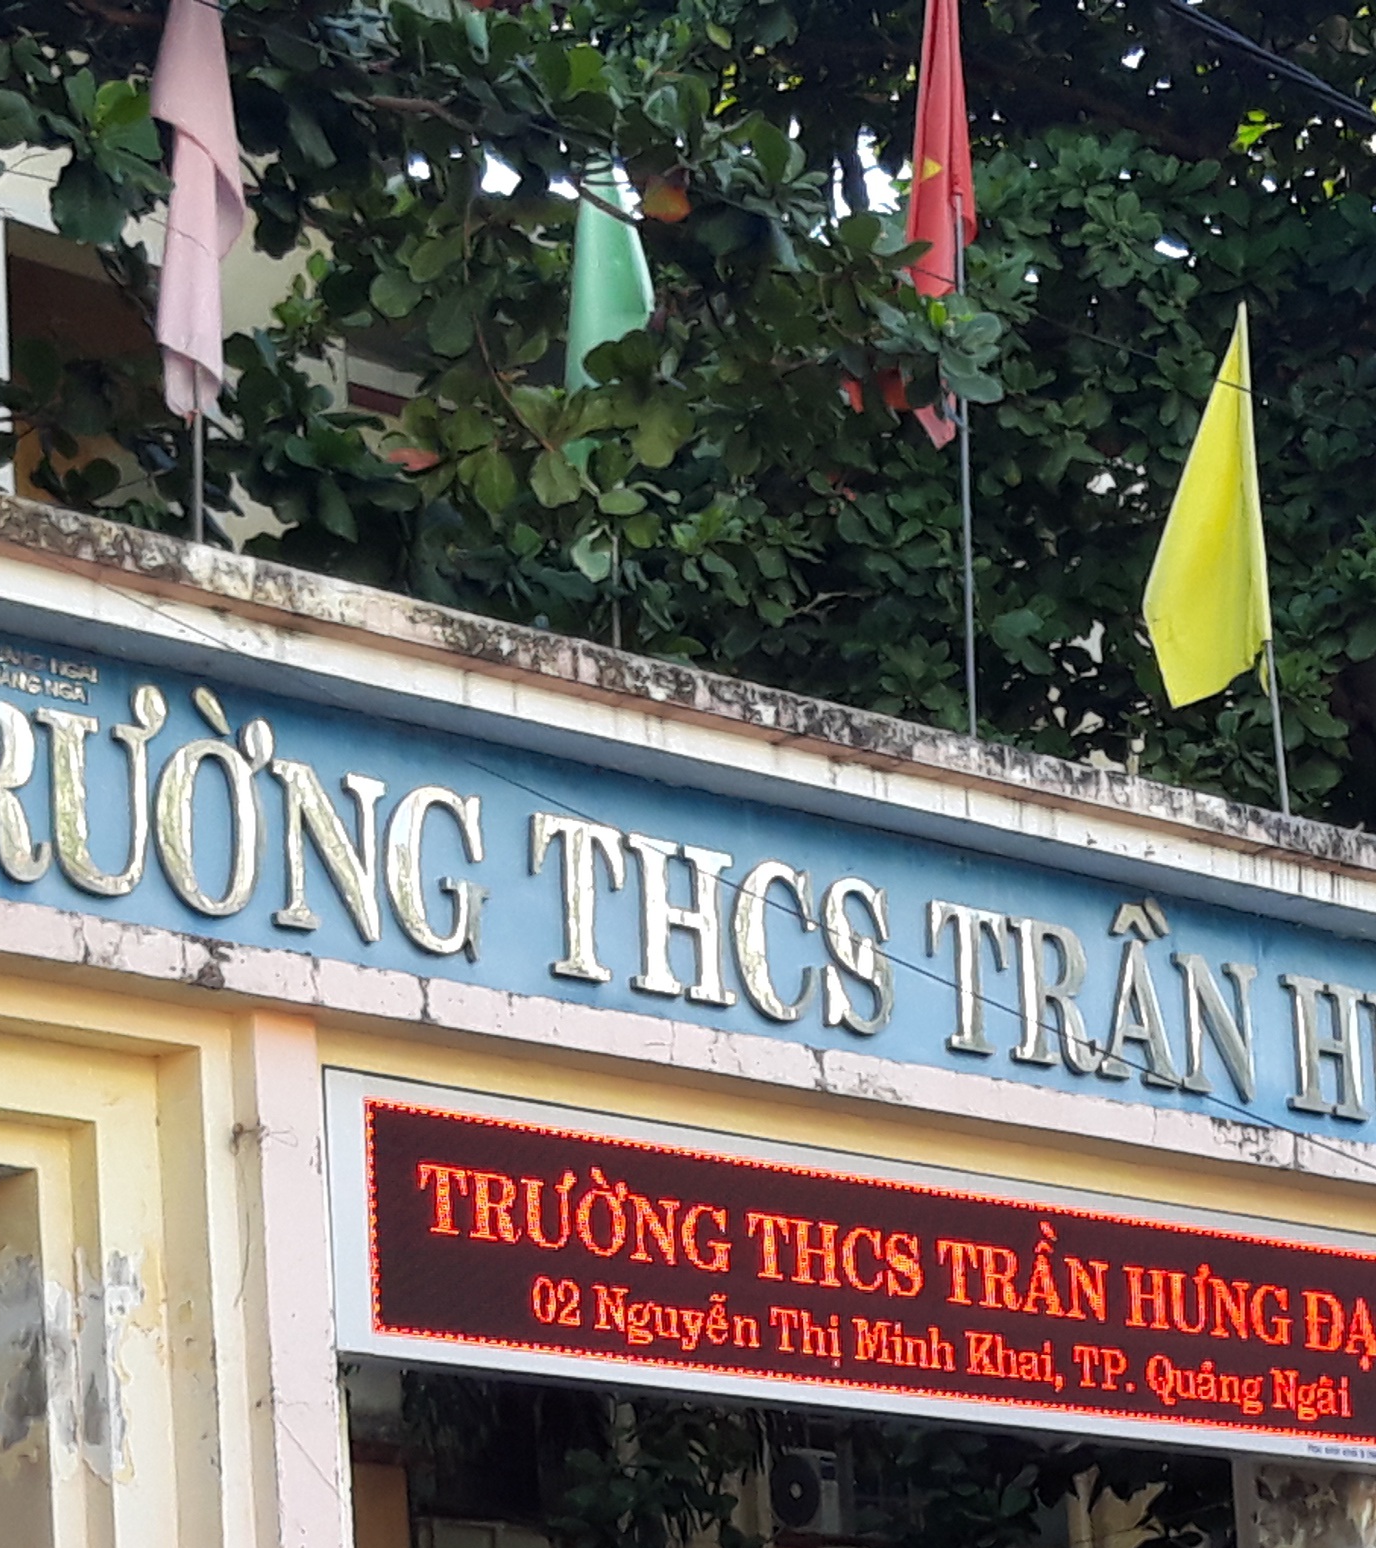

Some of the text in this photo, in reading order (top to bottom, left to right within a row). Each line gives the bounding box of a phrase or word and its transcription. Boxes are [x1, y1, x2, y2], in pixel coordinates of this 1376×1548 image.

[529, 810, 894, 1036] THCS
[926, 897, 1258, 1102] TRẦN
[417, 1161, 732, 1272] TRƯỜNG
[745, 1210, 924, 1298] THCS
[936, 1221, 1110, 1323] TRẦN
[1123, 1264, 1293, 1347] HƯNG
[531, 1276, 583, 1327] 02
[592, 1283, 761, 1352] Nguyễn
[769, 1304, 842, 1369] Thị
[851, 1316, 956, 1374] Minh
[965, 1329, 1064, 1394] Khai,
[1072, 1344, 1136, 1393] TP.
[1145, 1354, 1264, 1416] Quảng
